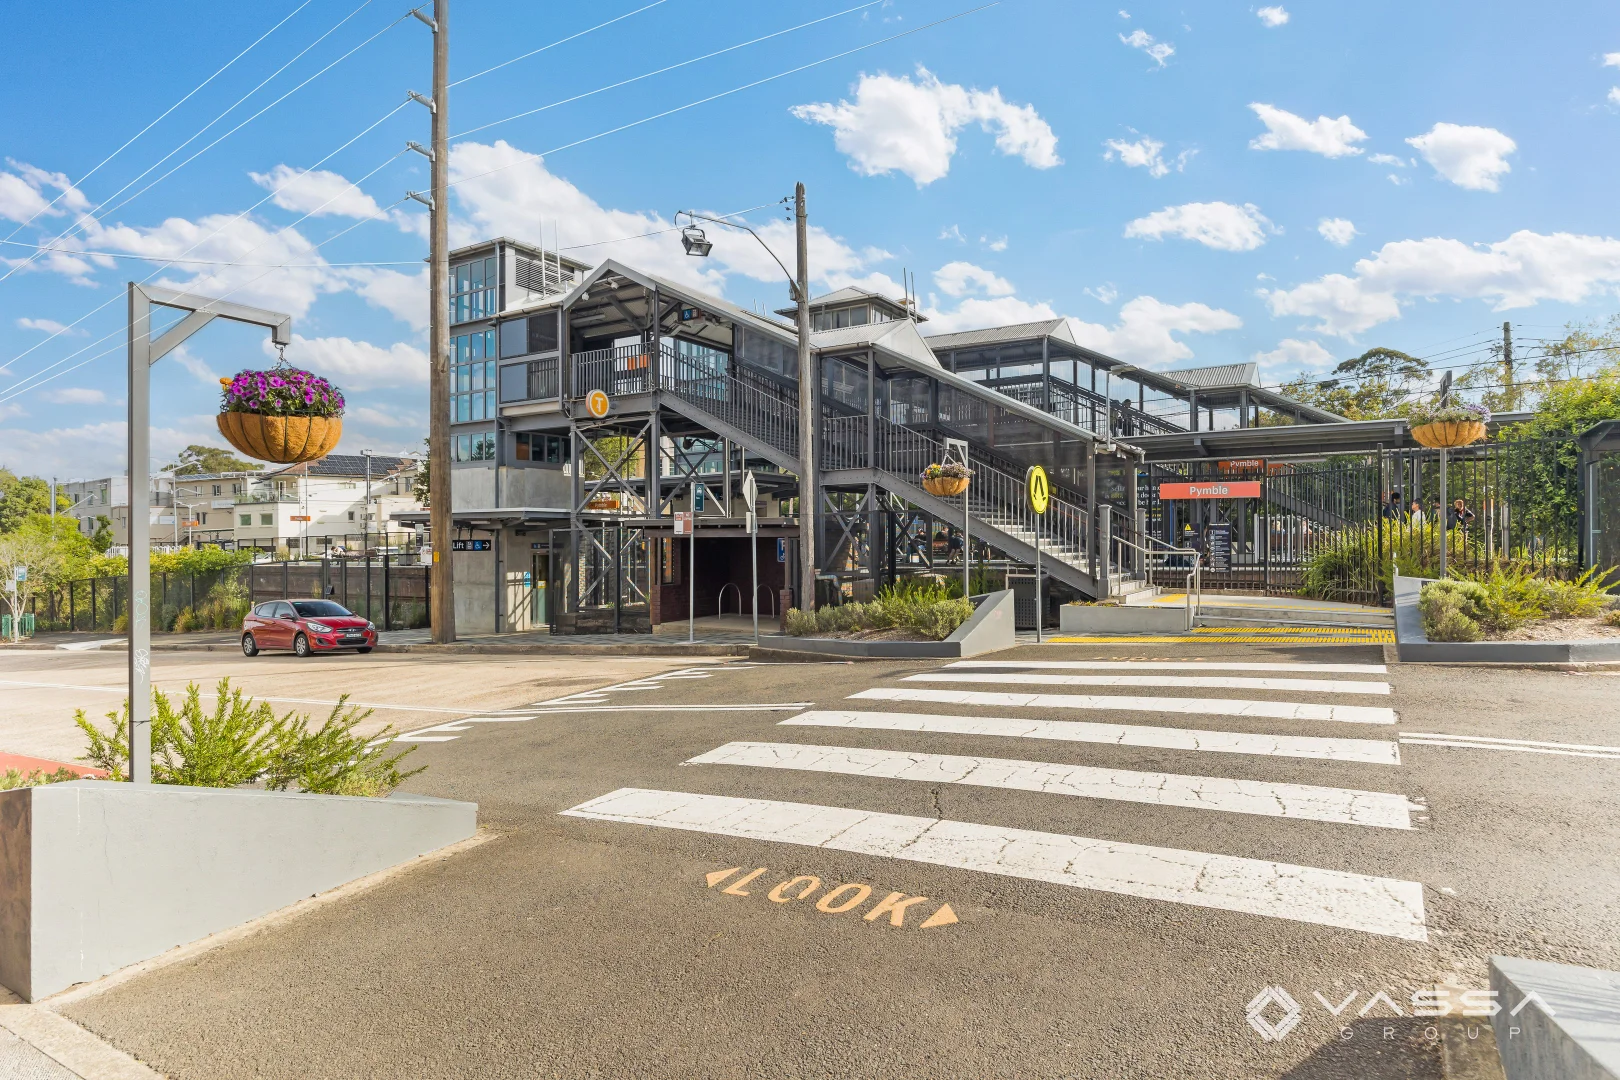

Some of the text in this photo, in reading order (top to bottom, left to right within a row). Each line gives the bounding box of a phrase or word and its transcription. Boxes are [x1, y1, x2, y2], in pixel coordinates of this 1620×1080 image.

[1230, 460, 1259, 468] Pymble
[1189, 485, 1229, 497] Pymble
[452, 541, 465, 549] Lift
[721, 867, 929, 927] LOOK
